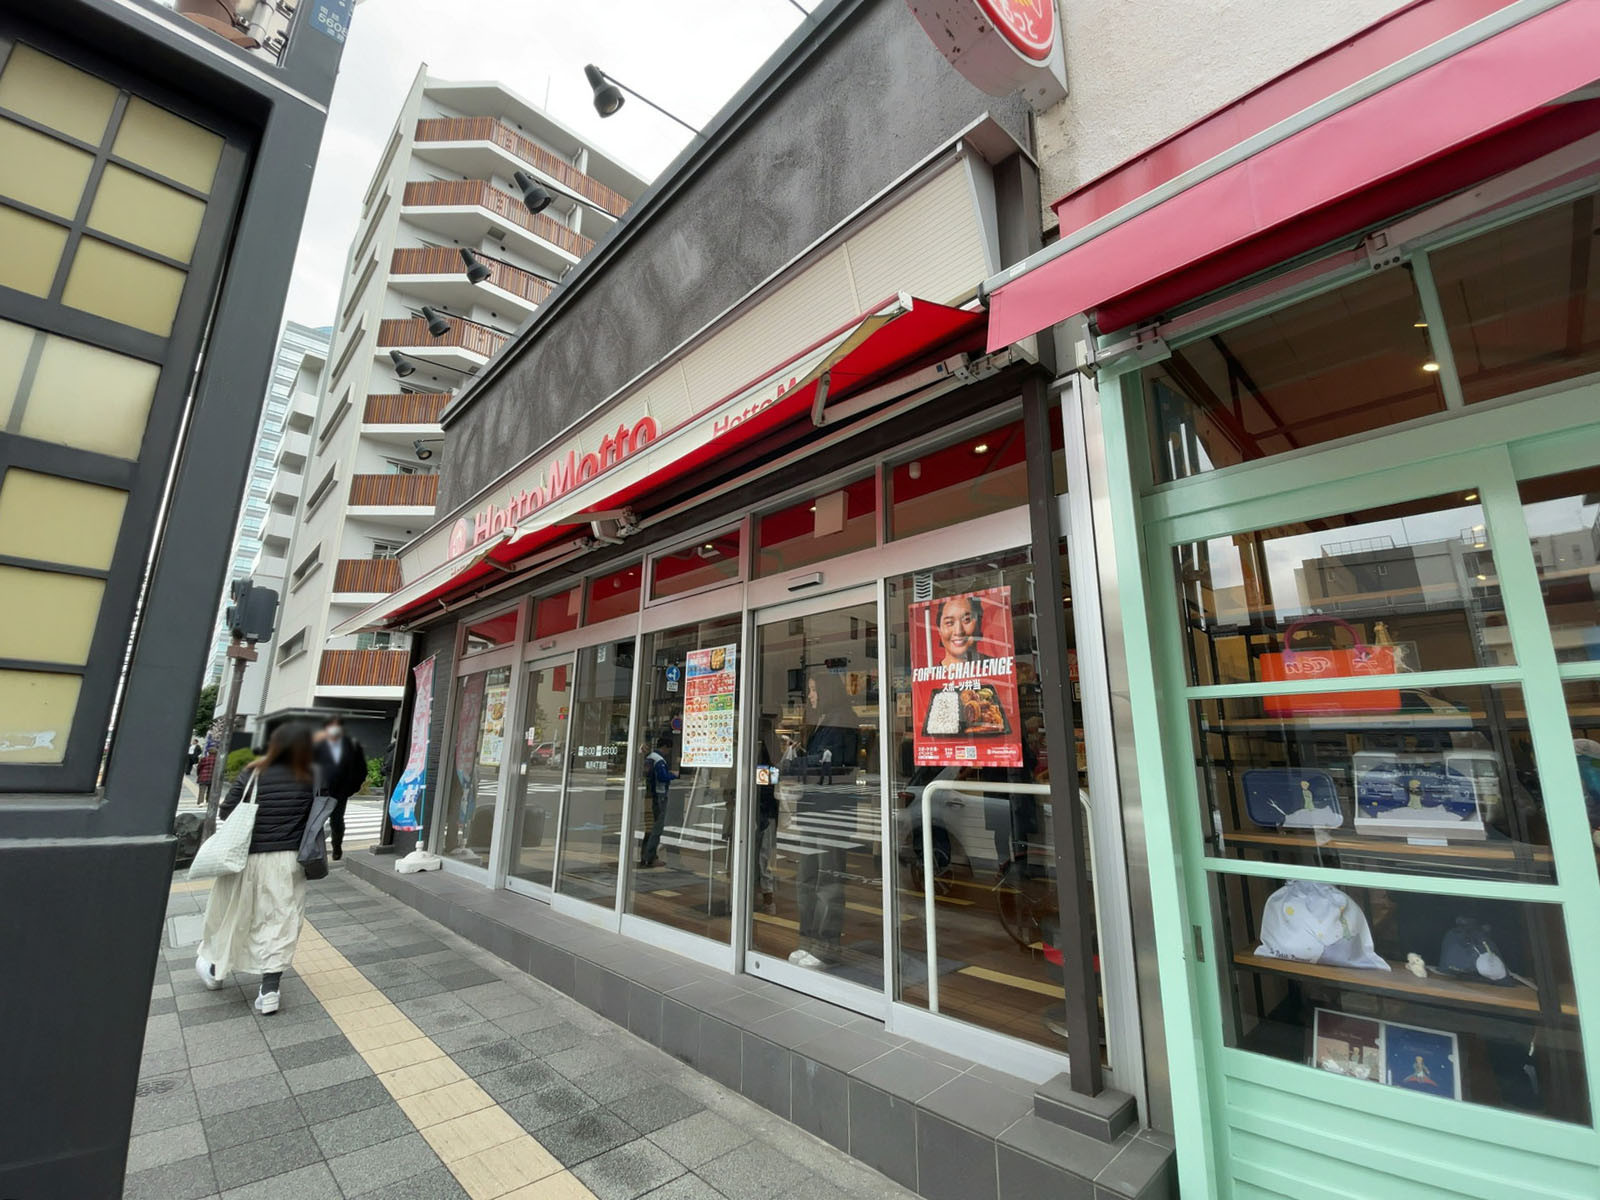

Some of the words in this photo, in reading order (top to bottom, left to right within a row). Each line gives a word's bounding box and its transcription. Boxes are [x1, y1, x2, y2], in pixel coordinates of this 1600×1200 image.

[929, 665, 947, 681] THE
[947, 656, 1013, 680] CHALLENGE
[941, 680, 981, 692] スポーツ弁当
